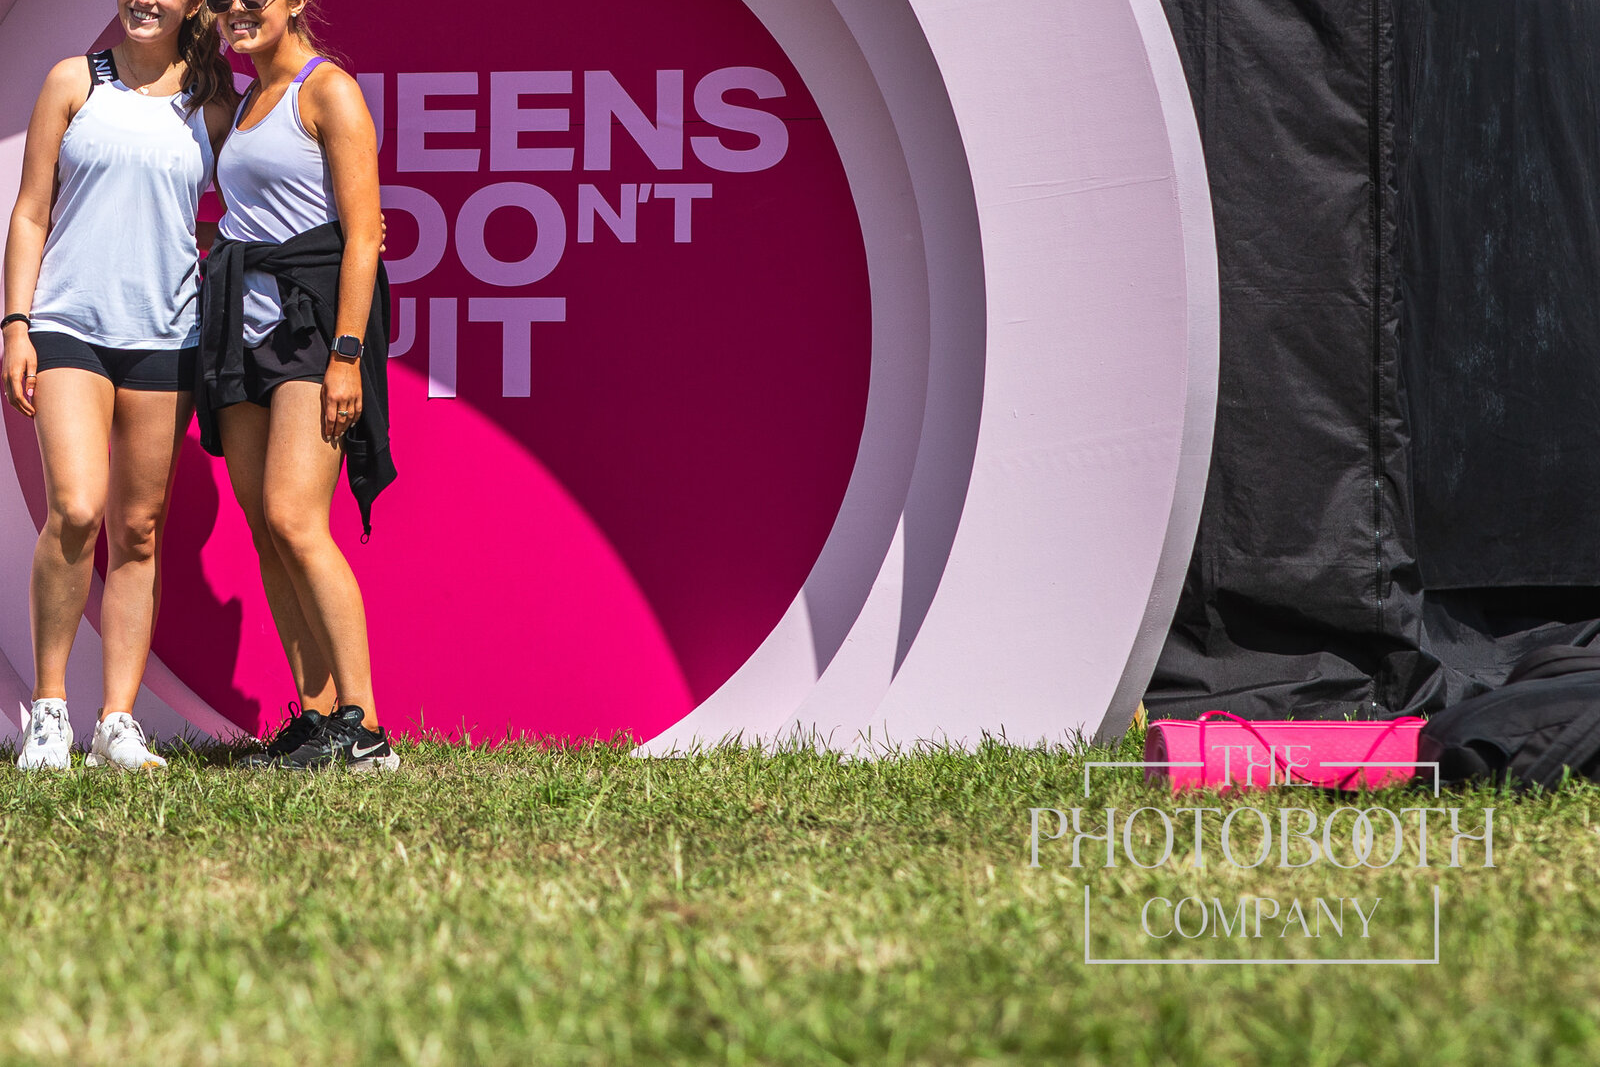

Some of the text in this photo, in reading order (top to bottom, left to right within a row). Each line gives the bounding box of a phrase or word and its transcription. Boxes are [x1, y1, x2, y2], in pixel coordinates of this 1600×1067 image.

[93, 58, 114, 84] NIK
[231, 66, 789, 173] EENS
[388, 297, 567, 398] IT
